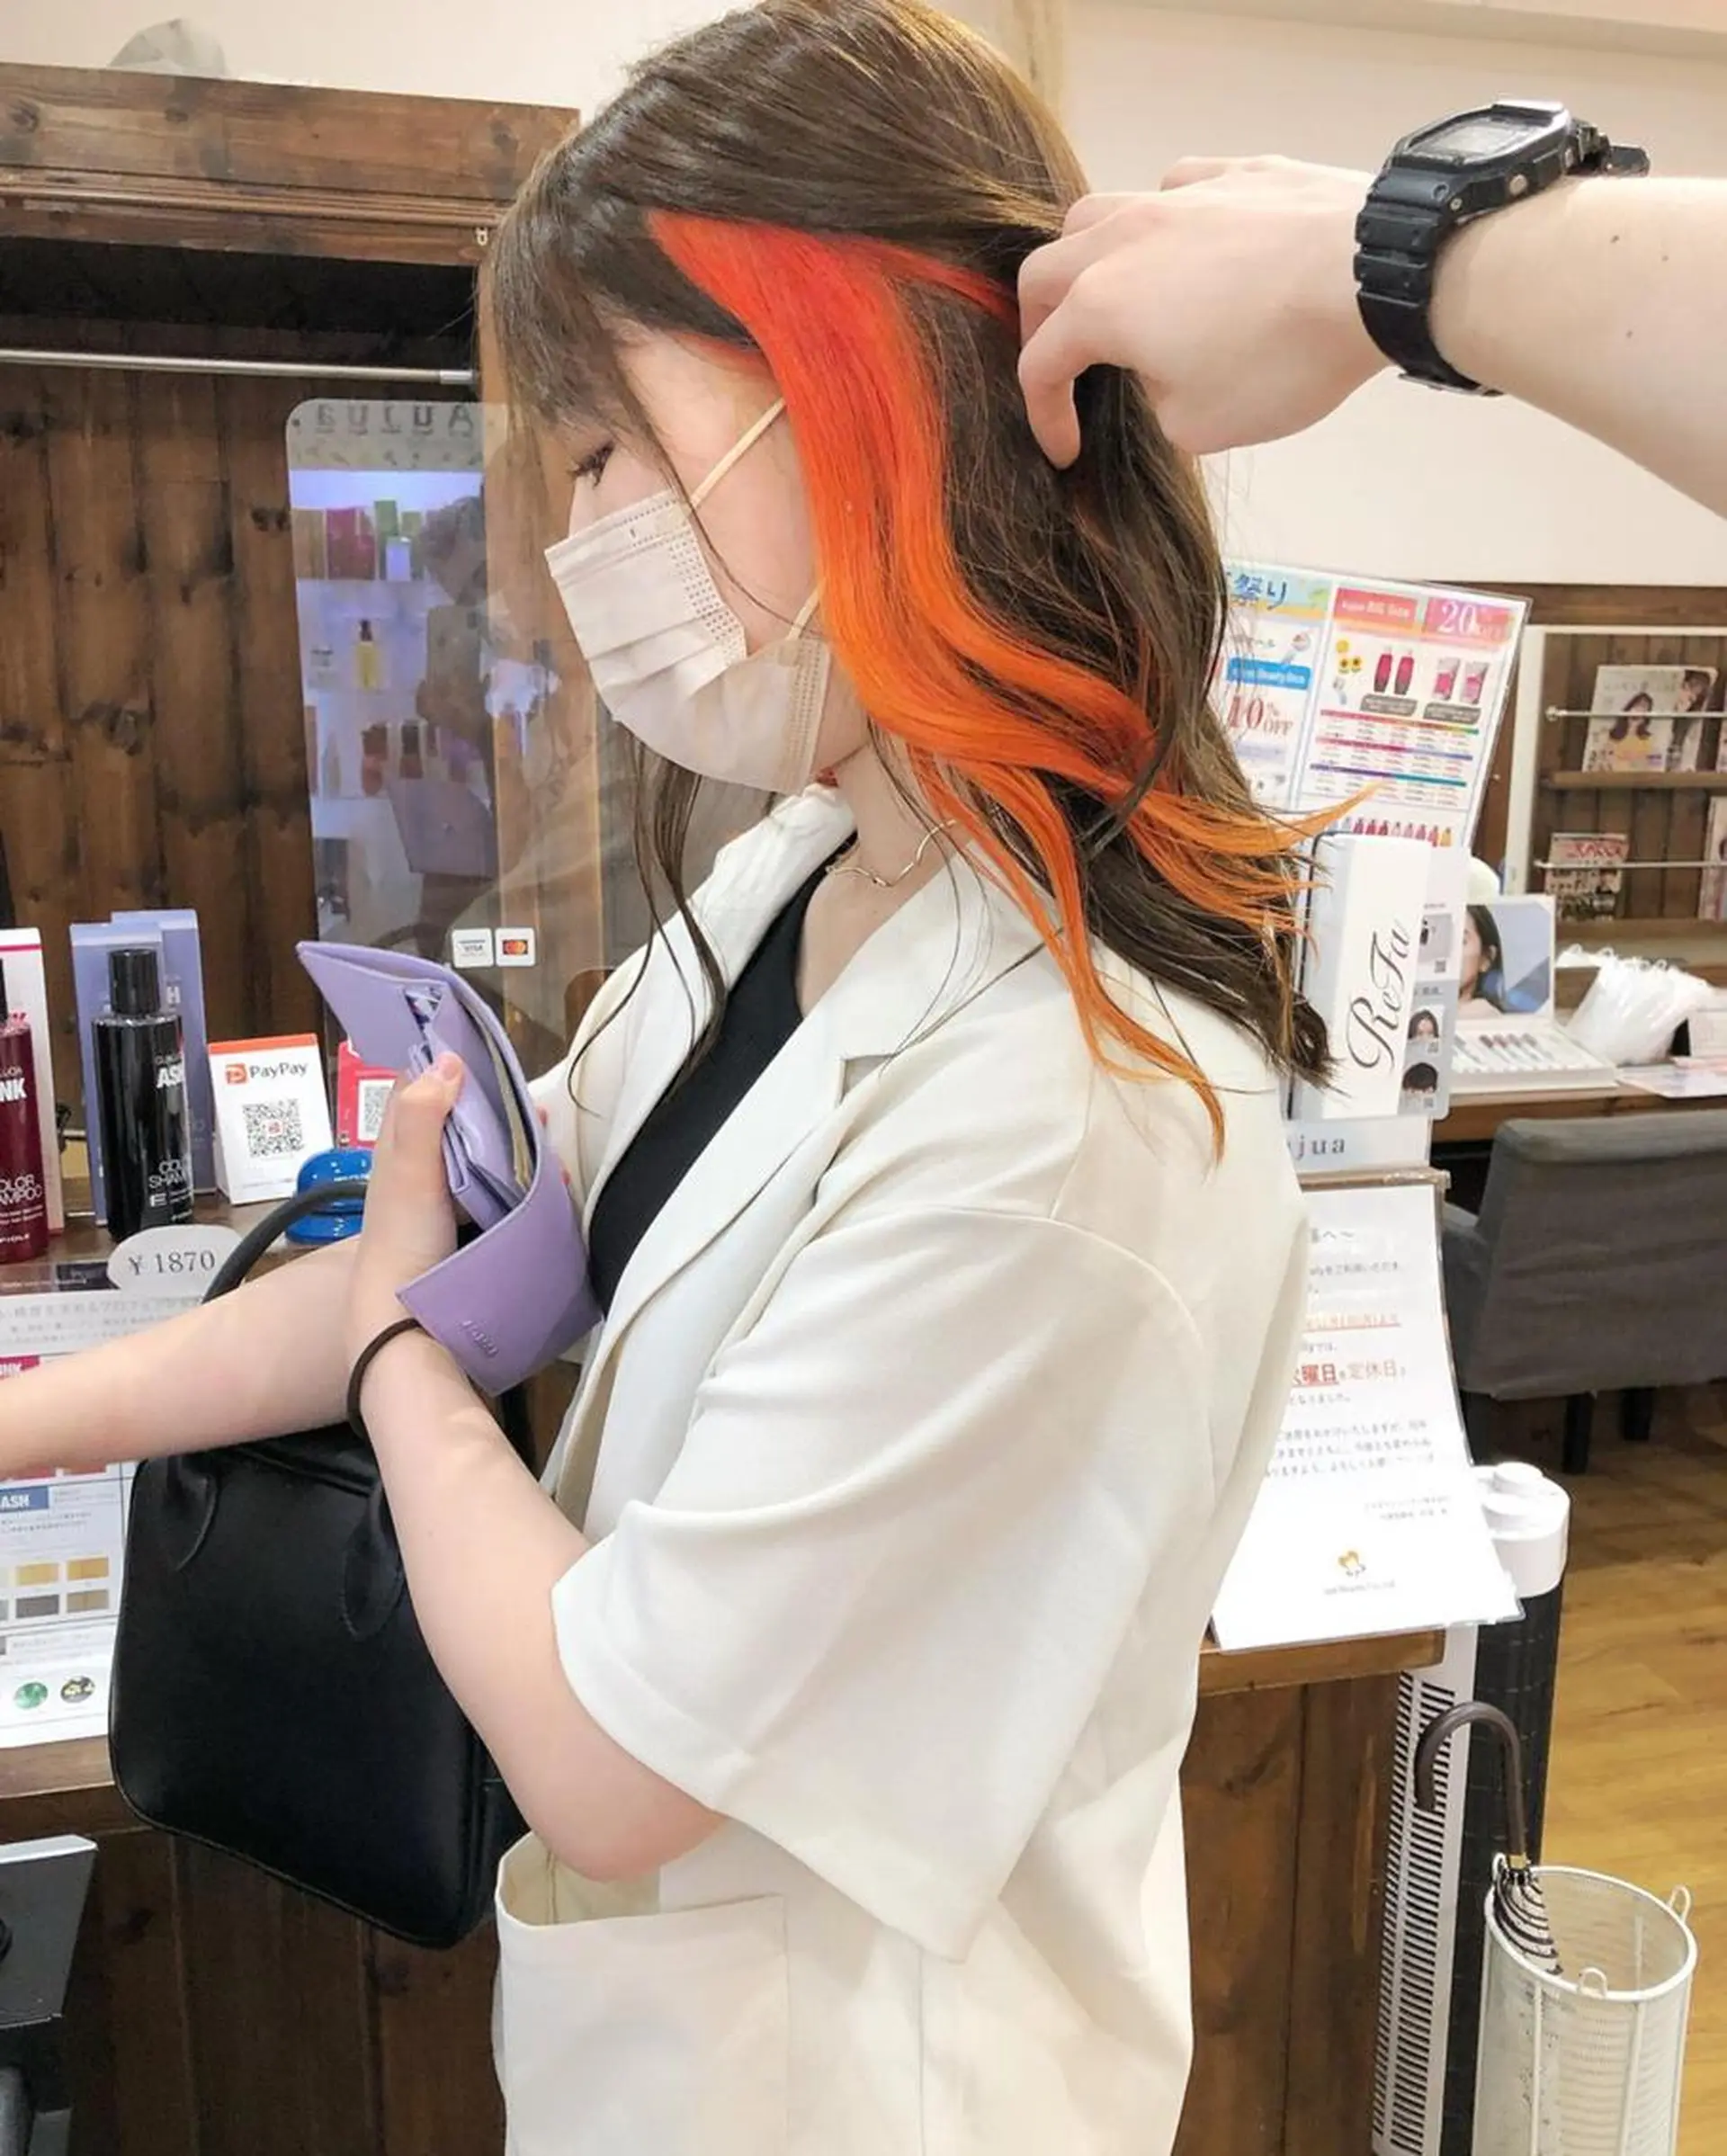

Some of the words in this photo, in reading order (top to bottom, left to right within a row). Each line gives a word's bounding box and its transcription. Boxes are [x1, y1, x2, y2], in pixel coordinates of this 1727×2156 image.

[1347, 917, 1410, 1073] ReFa
[250, 1062, 309, 1081] PayPay
[1287, 1133, 1345, 1162] jua
[156, 1251, 216, 1274] 1870
[1, 1493, 30, 1508] ASH
